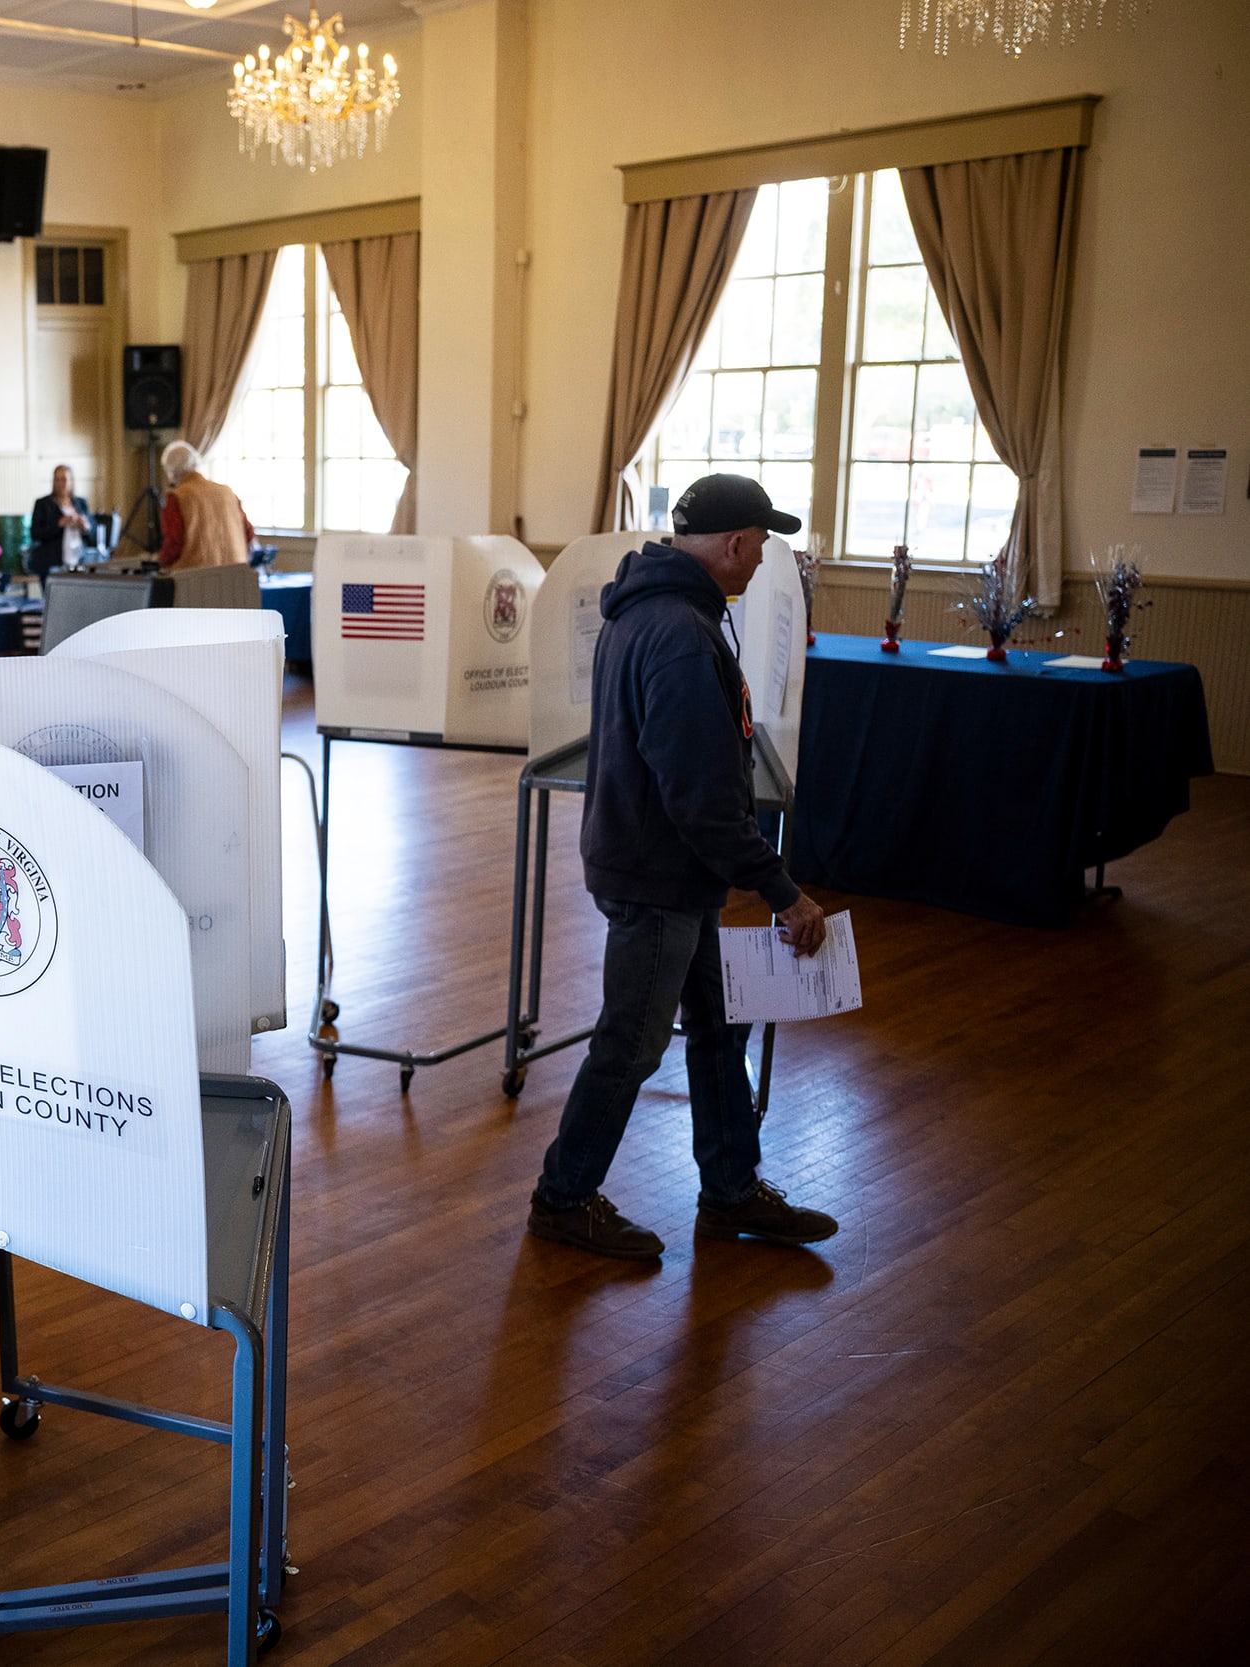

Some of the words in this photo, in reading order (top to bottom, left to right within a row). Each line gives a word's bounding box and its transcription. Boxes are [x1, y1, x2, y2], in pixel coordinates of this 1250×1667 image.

[72, 783, 119, 799] TION
[5, 839, 49, 903] VIRGINIA
[0, 1064, 153, 1117] ELECTIONS
[15, 1095, 127, 1137] COUNTY
